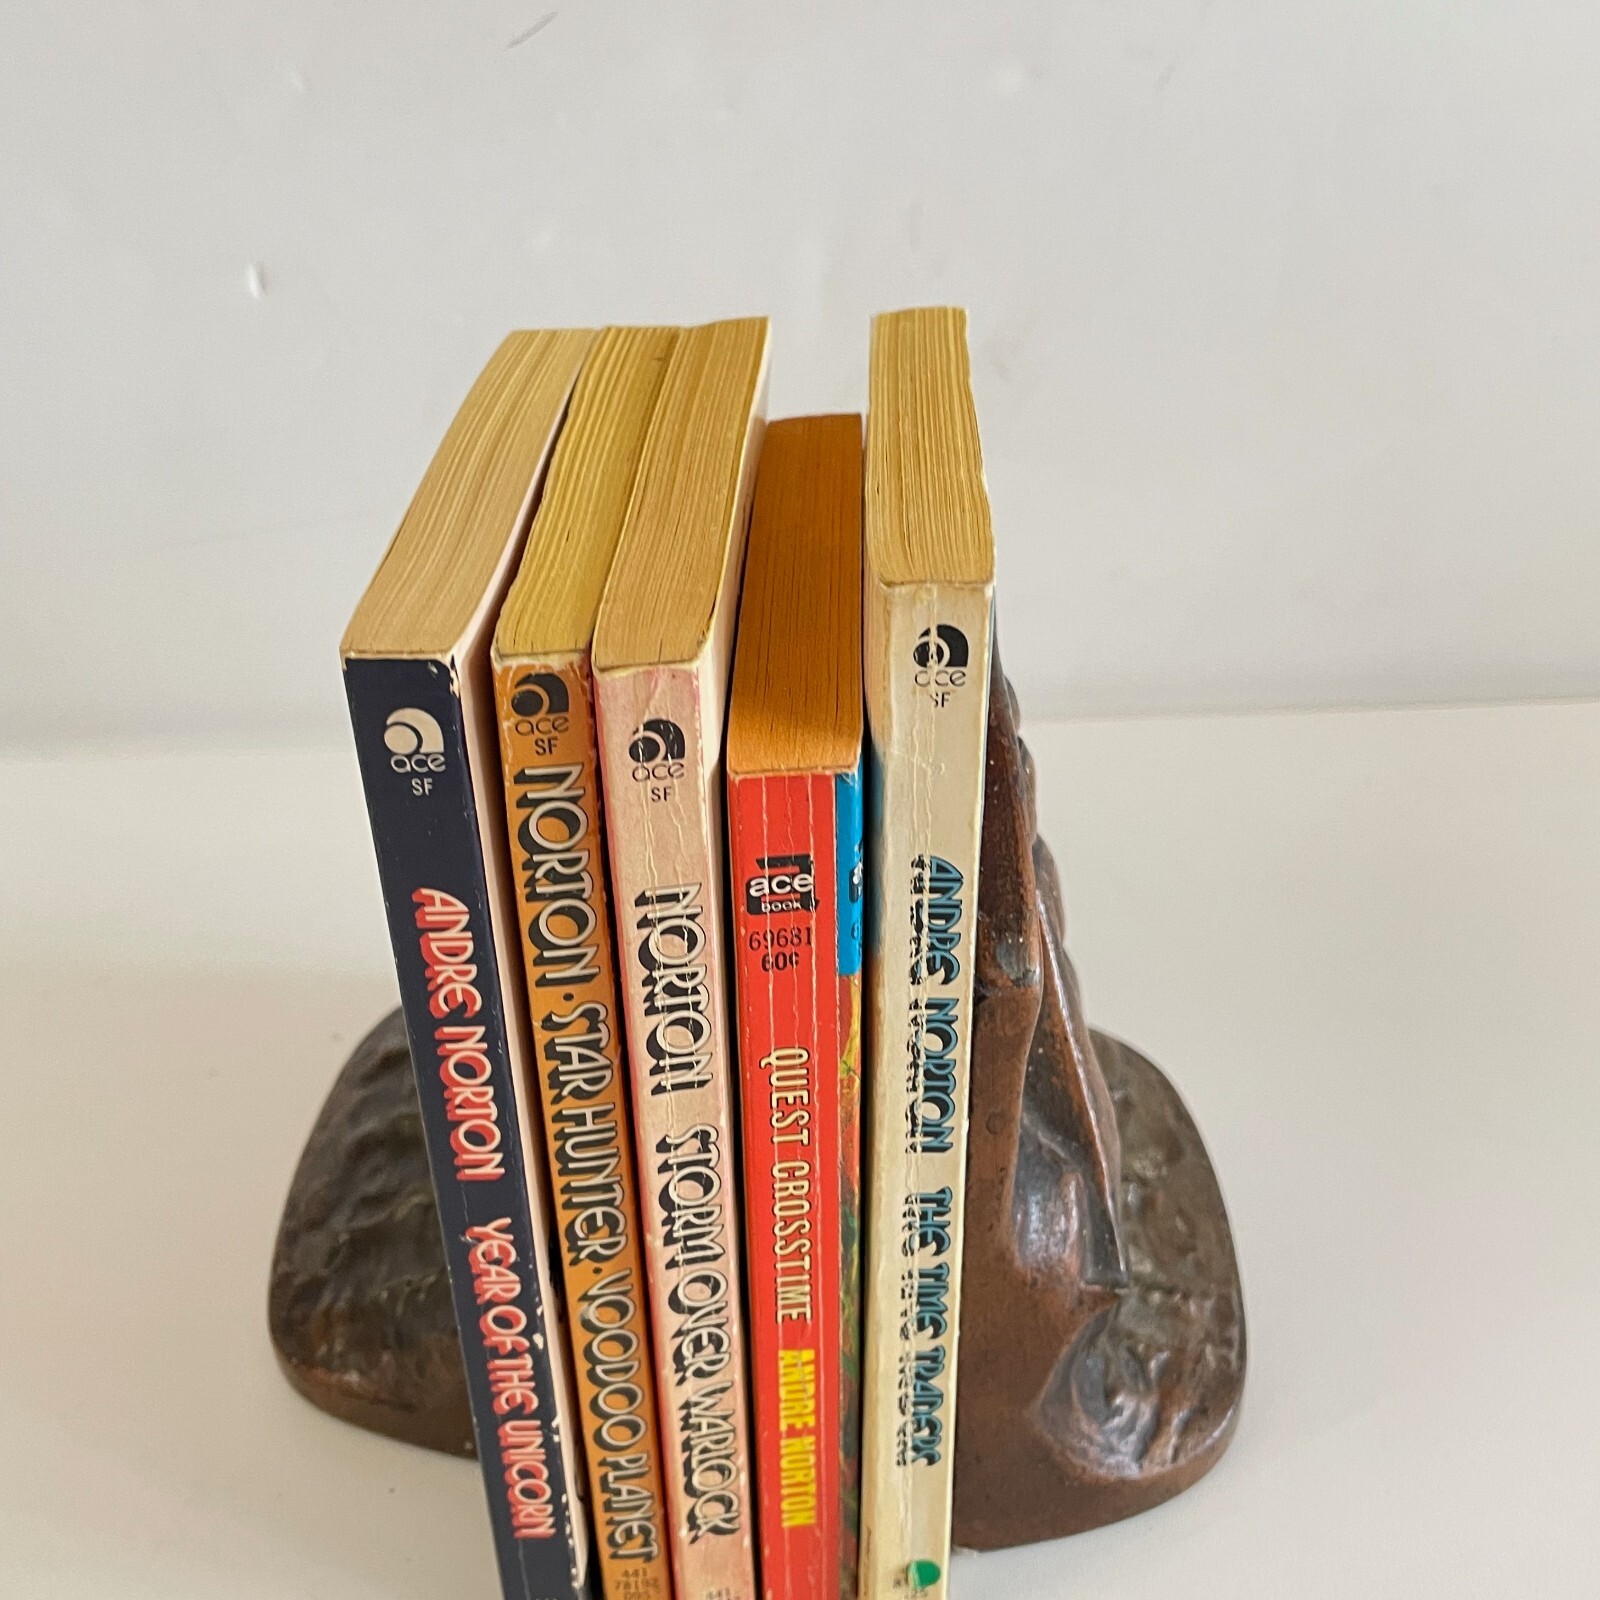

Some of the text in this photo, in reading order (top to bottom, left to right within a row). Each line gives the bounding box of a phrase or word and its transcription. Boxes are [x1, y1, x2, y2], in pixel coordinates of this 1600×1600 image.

[390, 753, 446, 773] ace
[515, 715, 569, 736] ace
[534, 738, 558, 756] SF
[632, 763, 684, 782] ace
[411, 778, 433, 797] SF
[651, 786, 671, 801] SF
[513, 762, 600, 988] NORTON
[749, 873, 813, 897] ace
[412, 888, 482, 1019] ANDRE
[749, 927, 813, 951] 69681
[541, 1002, 614, 1105] STAR
[434, 1026, 505, 1181] NORTON
[551, 1103, 628, 1266] HUNTER
[896, 854, 964, 1466] ANDRE NORTON THE TIME TRADERS
[465, 1217, 523, 1305] YEAR
[634, 883, 741, 1545] NORTON STORM OVER WARLOCK
[479, 1305, 531, 1355] OF
[759, 1046, 818, 1529] QUEST CROSSTIME ANDRE NORTON
[486, 1355, 539, 1416] THE
[579, 1268, 648, 1452] VOODOO
[497, 1419, 555, 1539] UNICORN
[597, 1452, 660, 1562] PLANET
